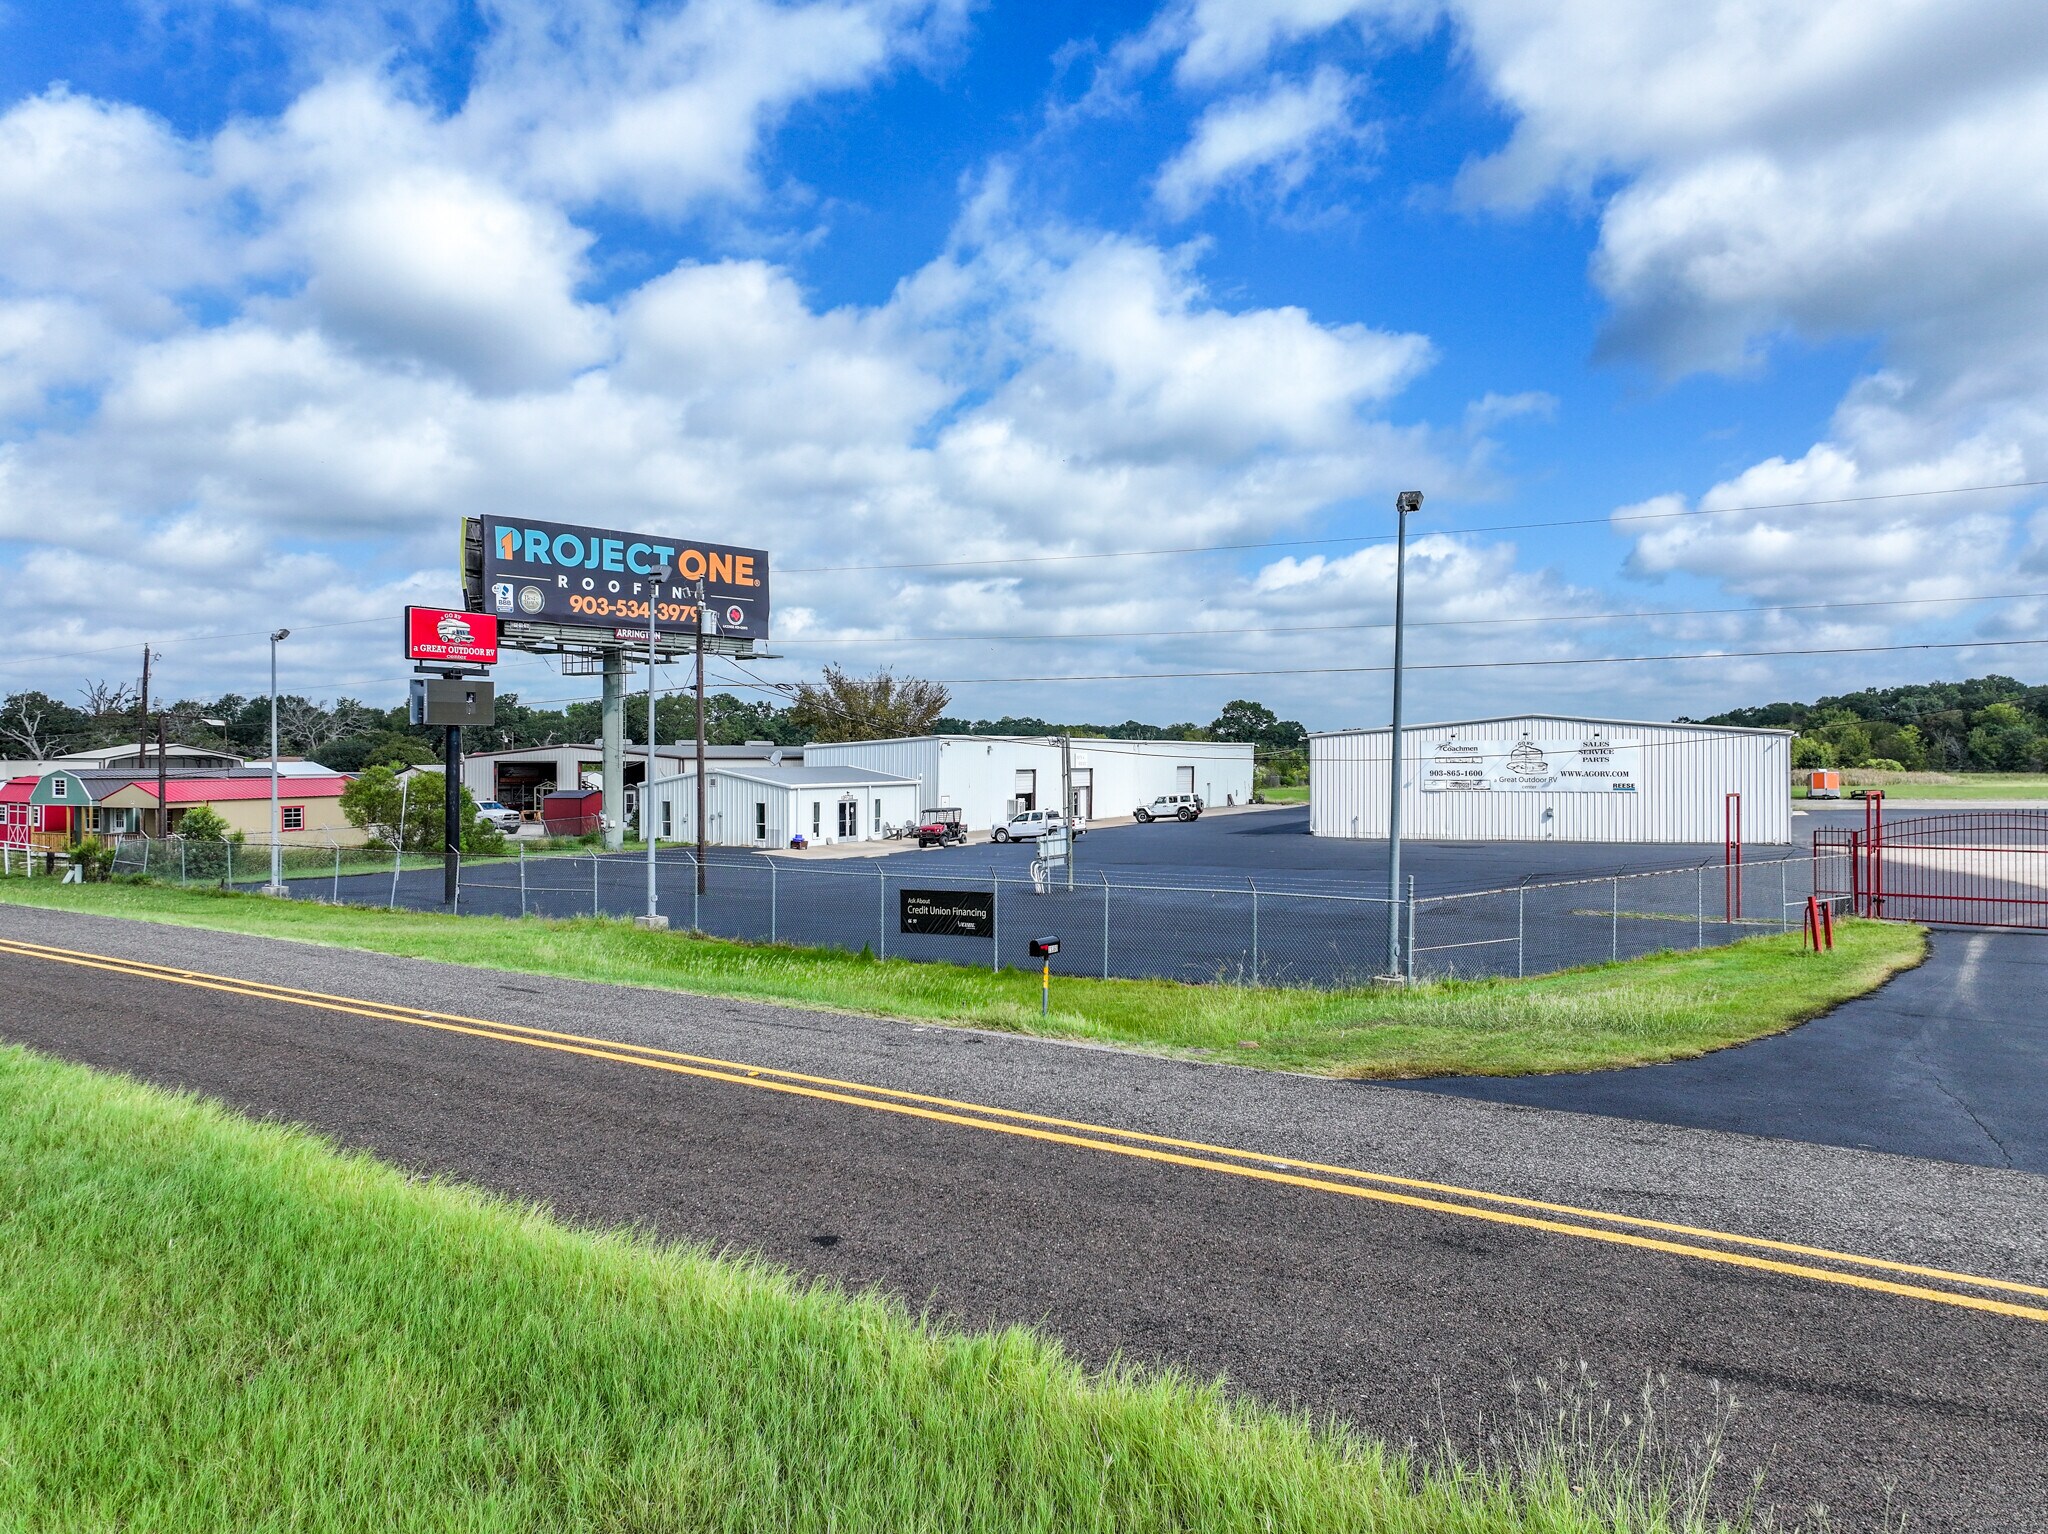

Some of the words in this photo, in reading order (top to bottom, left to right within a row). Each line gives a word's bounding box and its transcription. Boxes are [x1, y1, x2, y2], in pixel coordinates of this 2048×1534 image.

[495, 526, 675, 576] PROJECT
[678, 549, 754, 587] ONE
[569, 594, 698, 622] 903-534-3979
[616, 628, 661, 640] ARRINGTN
[420, 644, 446, 653] GREAT
[448, 646, 485, 656] OUTDOOR
[485, 649, 495, 657] RV
[907, 905, 929, 915] Credit
[929, 906, 951, 916] Union
[952, 907, 987, 920] Financing
